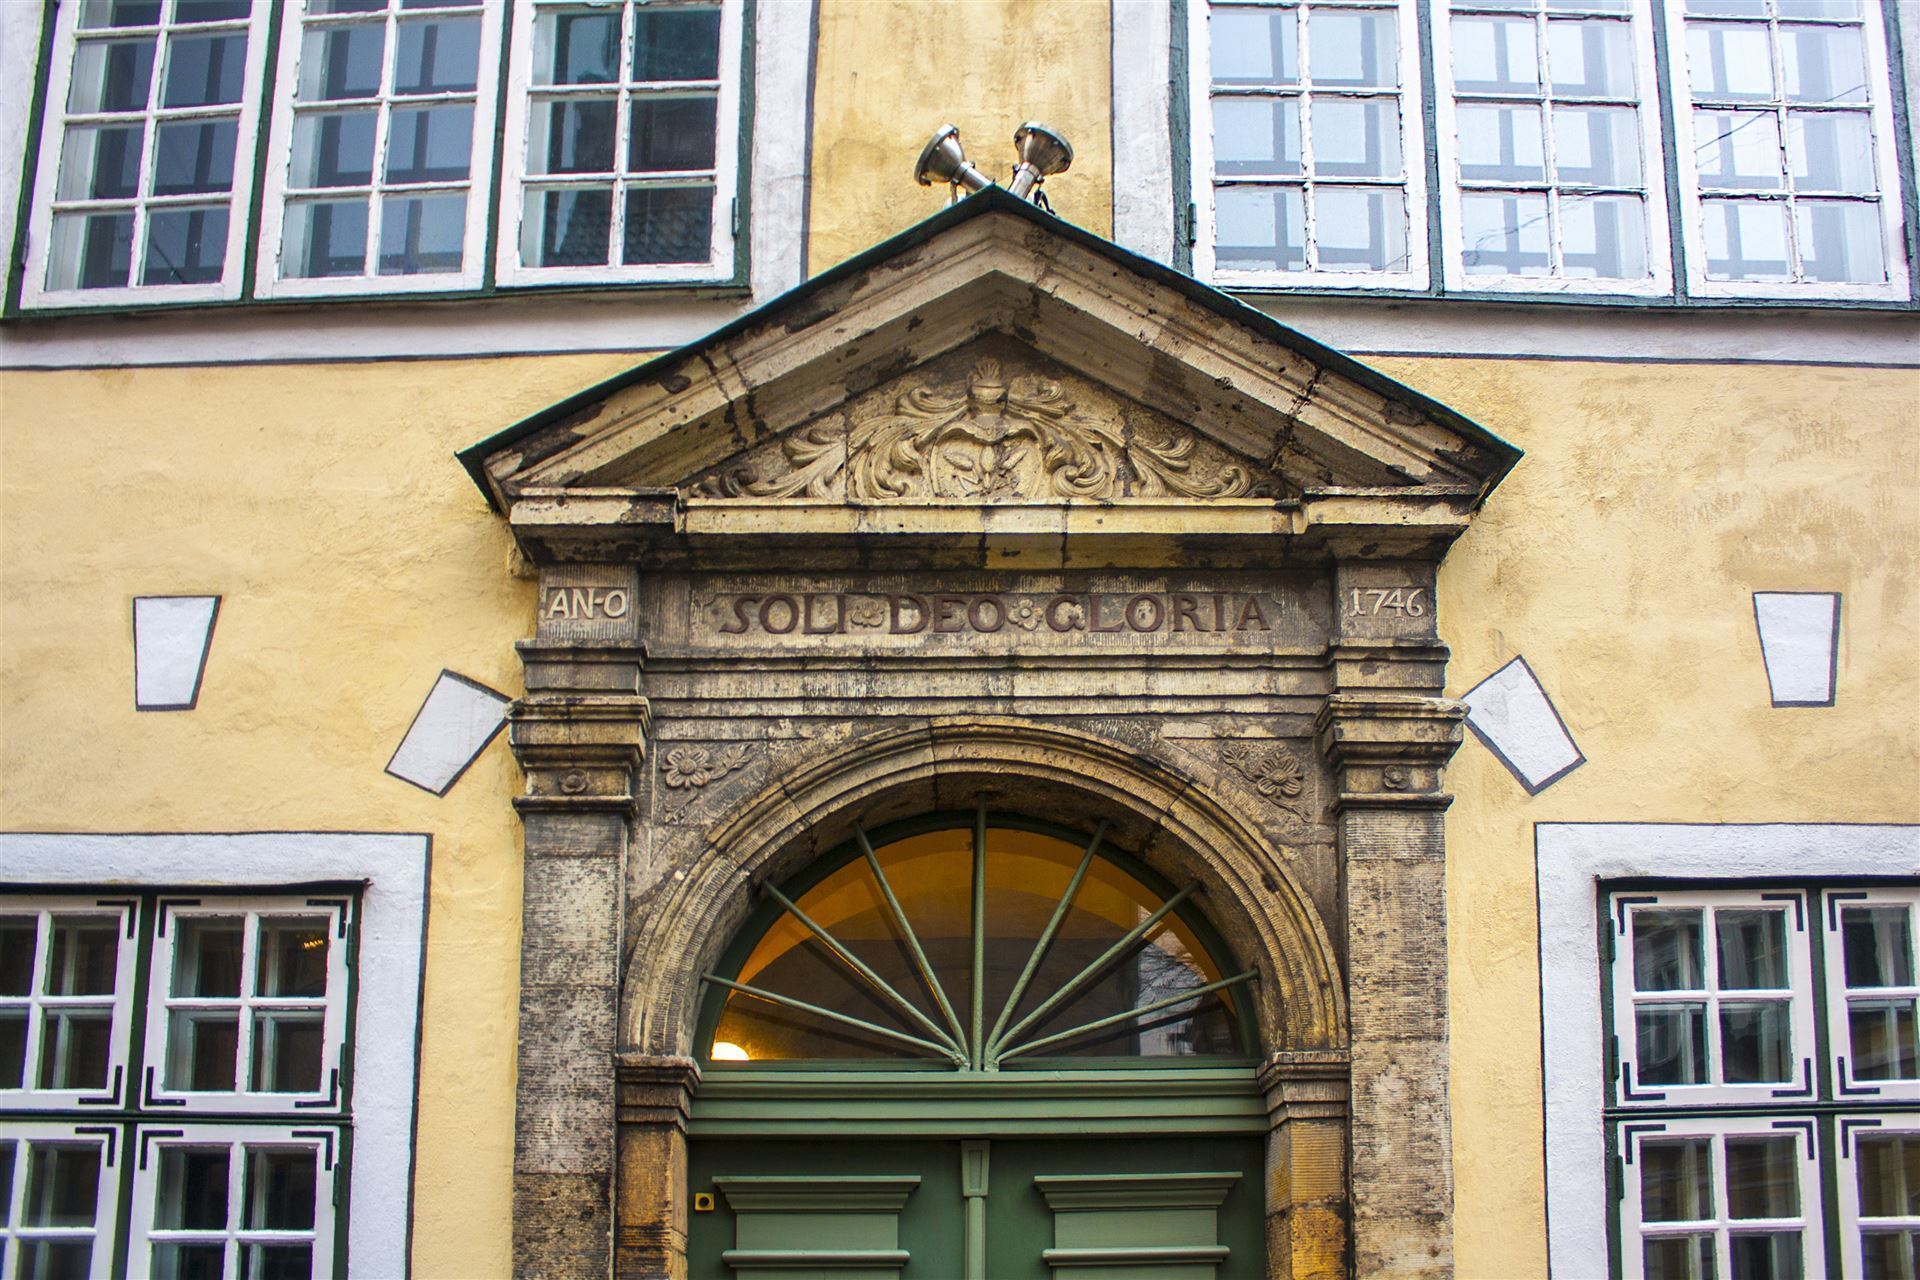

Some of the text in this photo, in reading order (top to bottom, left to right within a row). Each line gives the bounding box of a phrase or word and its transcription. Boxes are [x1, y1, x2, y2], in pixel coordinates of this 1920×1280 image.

[719, 592, 1272, 635] SOLI DEO GLORIA
[1348, 587, 1424, 618] 1746
